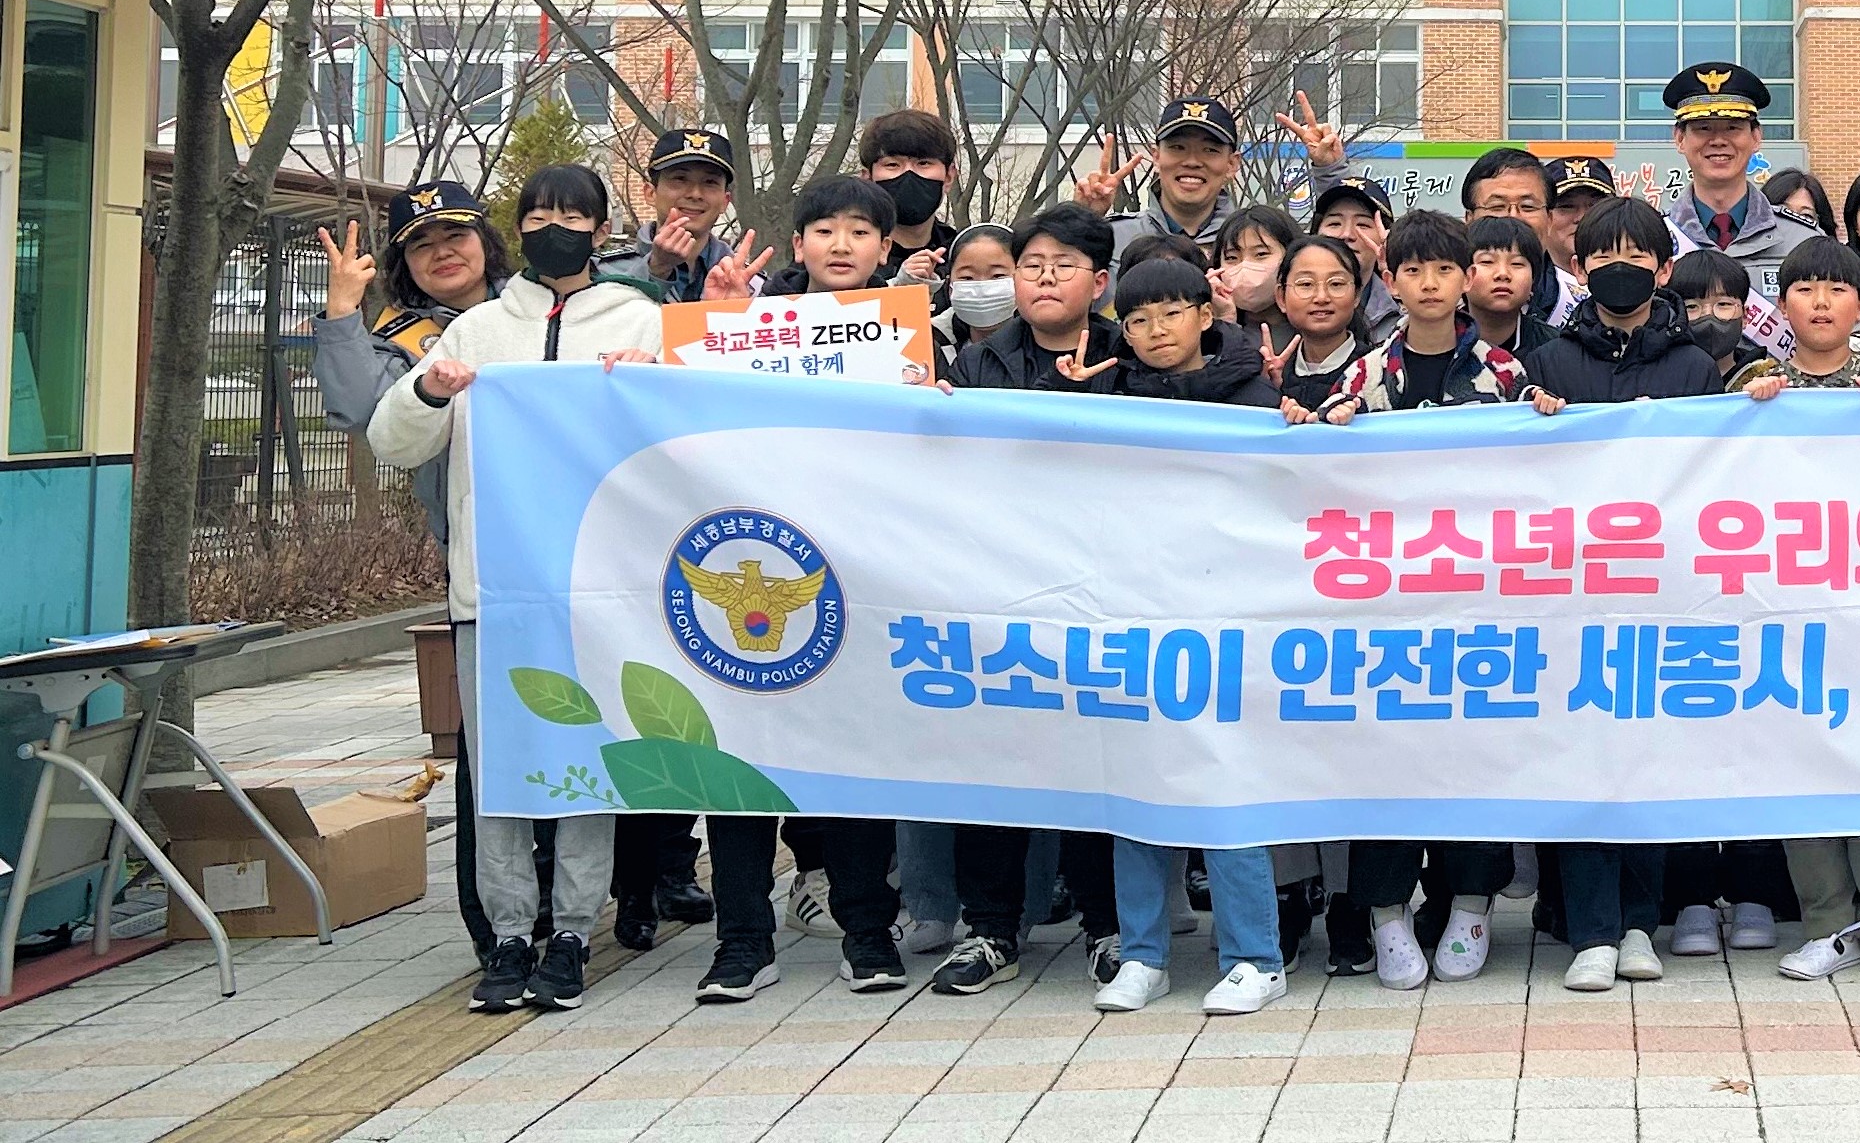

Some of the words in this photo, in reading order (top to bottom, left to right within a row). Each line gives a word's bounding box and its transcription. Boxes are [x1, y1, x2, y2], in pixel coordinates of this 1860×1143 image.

[703, 326, 800, 355] 학교폭력
[811, 321, 882, 346] ZERO
[800, 352, 844, 375] 함께
[690, 516, 812, 562] 세종남부경찰서
[1304, 501, 1666, 599] 청소년은
[671, 590, 702, 651] SEJONG
[700, 650, 755, 684] NAMBU
[761, 656, 816, 685] POLICE
[813, 599, 838, 659] STATION
[888, 616, 1244, 723] 청소년이
[1271, 624, 1548, 722] 안전한
[1567, 623, 1850, 729] 세종시,
